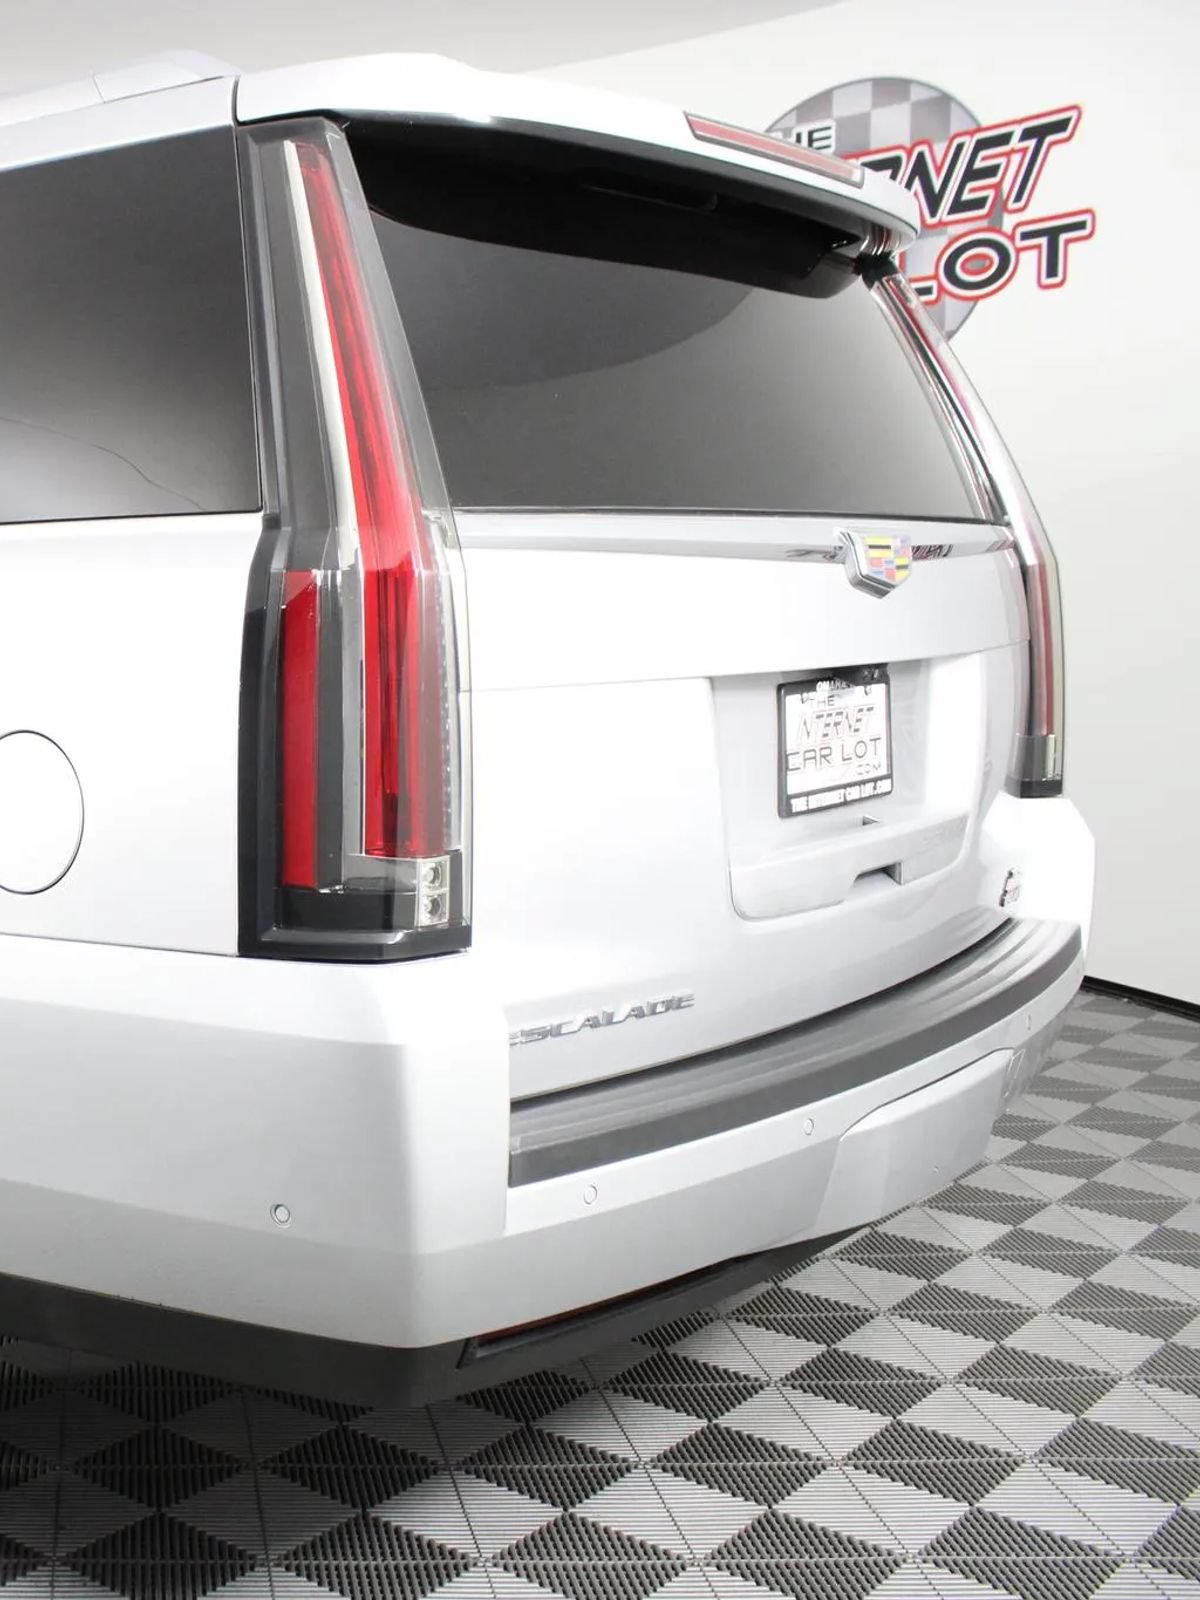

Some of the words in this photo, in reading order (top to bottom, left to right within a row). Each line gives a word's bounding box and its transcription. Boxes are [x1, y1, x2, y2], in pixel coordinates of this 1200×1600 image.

[915, 219, 1088, 297] OT
[787, 746, 833, 772] CAR
[842, 737, 882, 761] LOT
